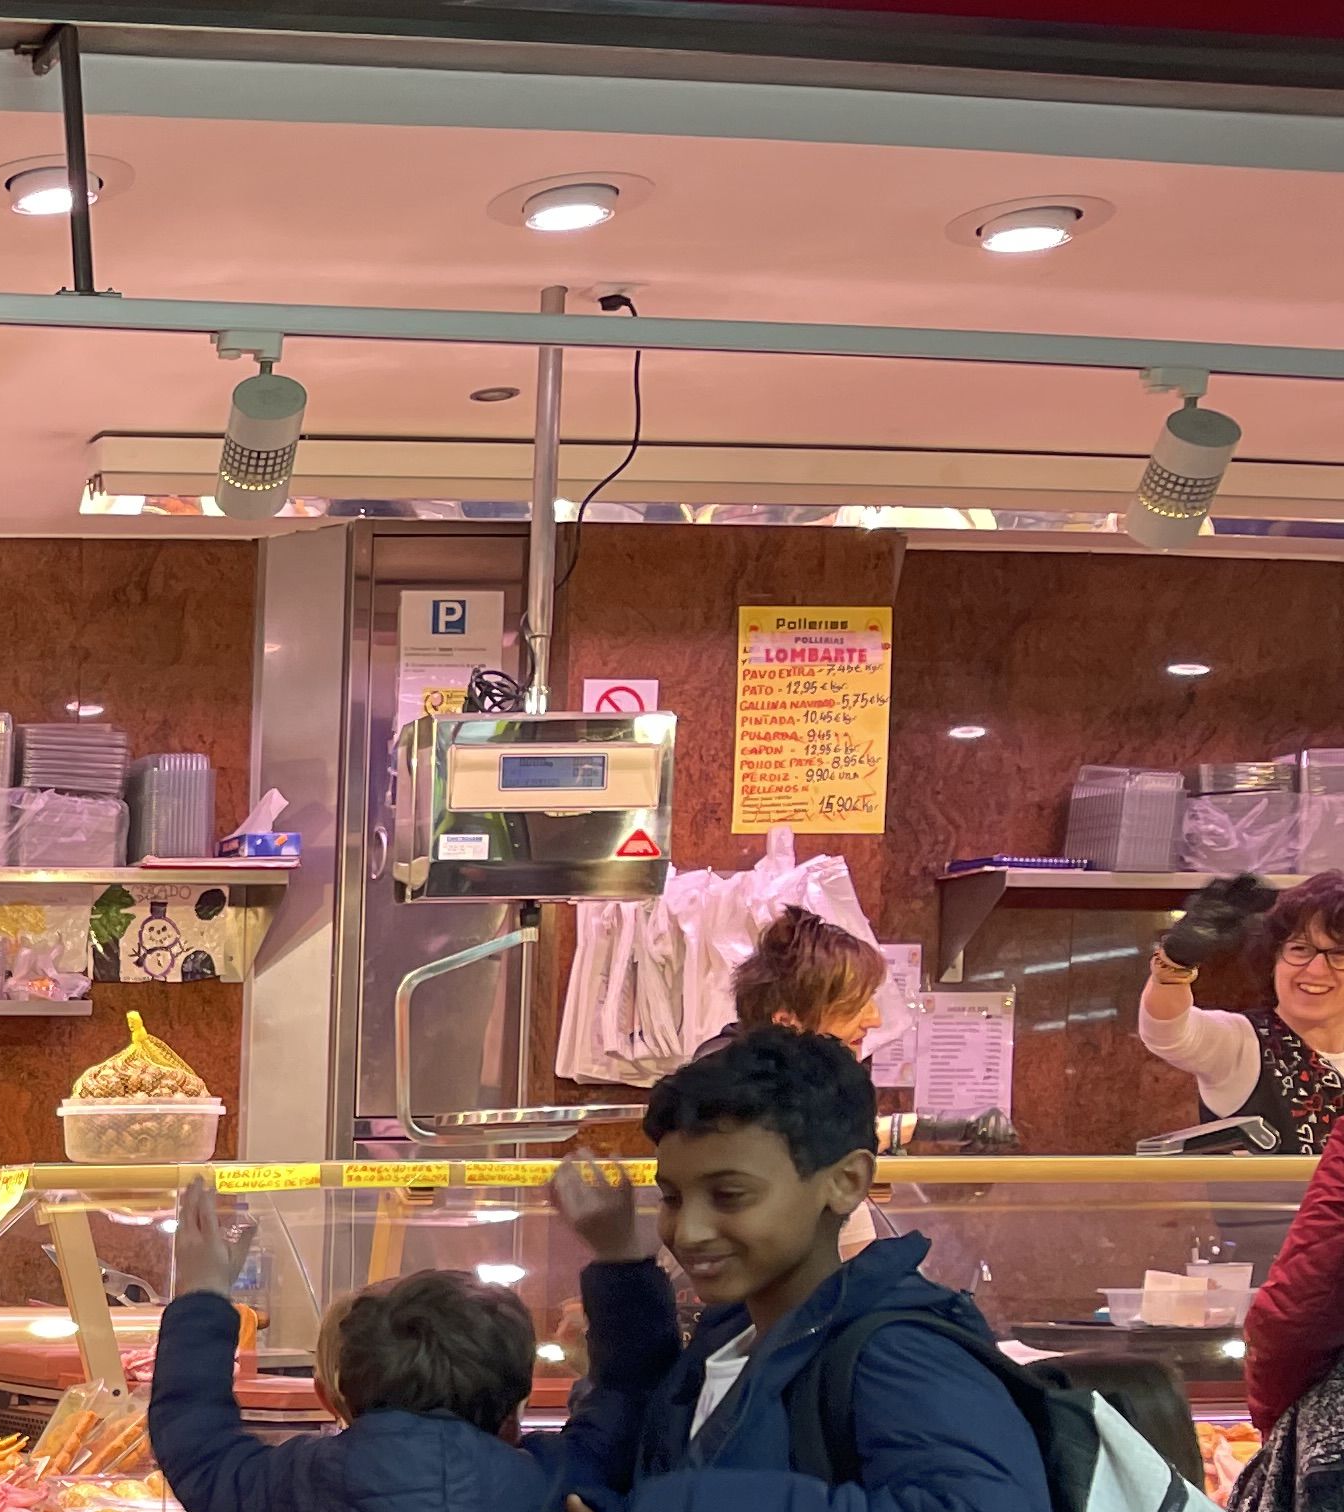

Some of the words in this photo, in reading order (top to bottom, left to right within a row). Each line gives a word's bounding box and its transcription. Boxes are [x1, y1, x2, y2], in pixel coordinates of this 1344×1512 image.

[794, 636, 844, 645] POLLERIAS
[765, 648, 867, 663] LOMBARTE
[743, 668, 776, 681] PAVO
[742, 684, 774, 697] PATO
[740, 699, 787, 712] GALLINA
[741, 714, 795, 727] PINTADA
[742, 772, 789, 783] PERDIZ
